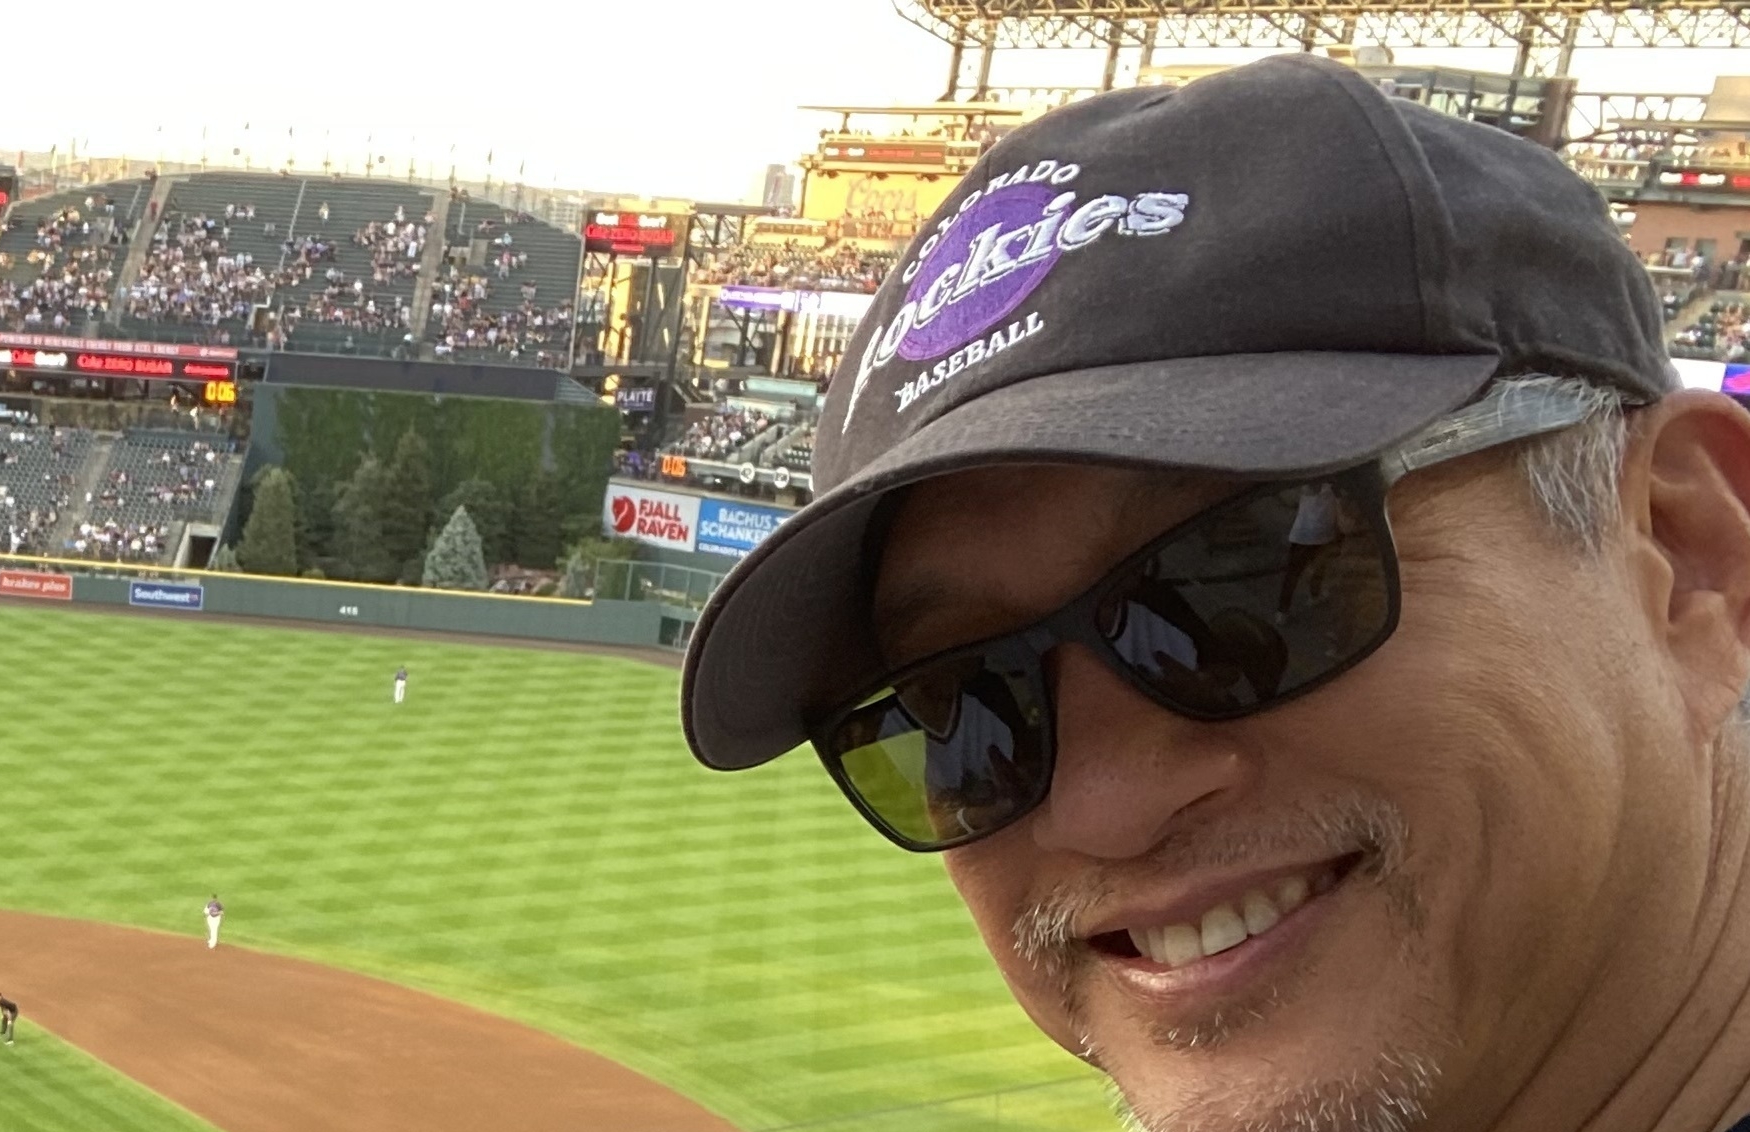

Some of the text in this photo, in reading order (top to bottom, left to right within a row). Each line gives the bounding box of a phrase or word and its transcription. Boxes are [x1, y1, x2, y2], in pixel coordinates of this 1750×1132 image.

[902, 158, 1081, 284] COLORADO
[895, 311, 1044, 413] BASEBALL
[617, 390, 653, 402] PLATTE
[718, 507, 773, 530] BACHUS
[134, 587, 190, 603] Southwest
